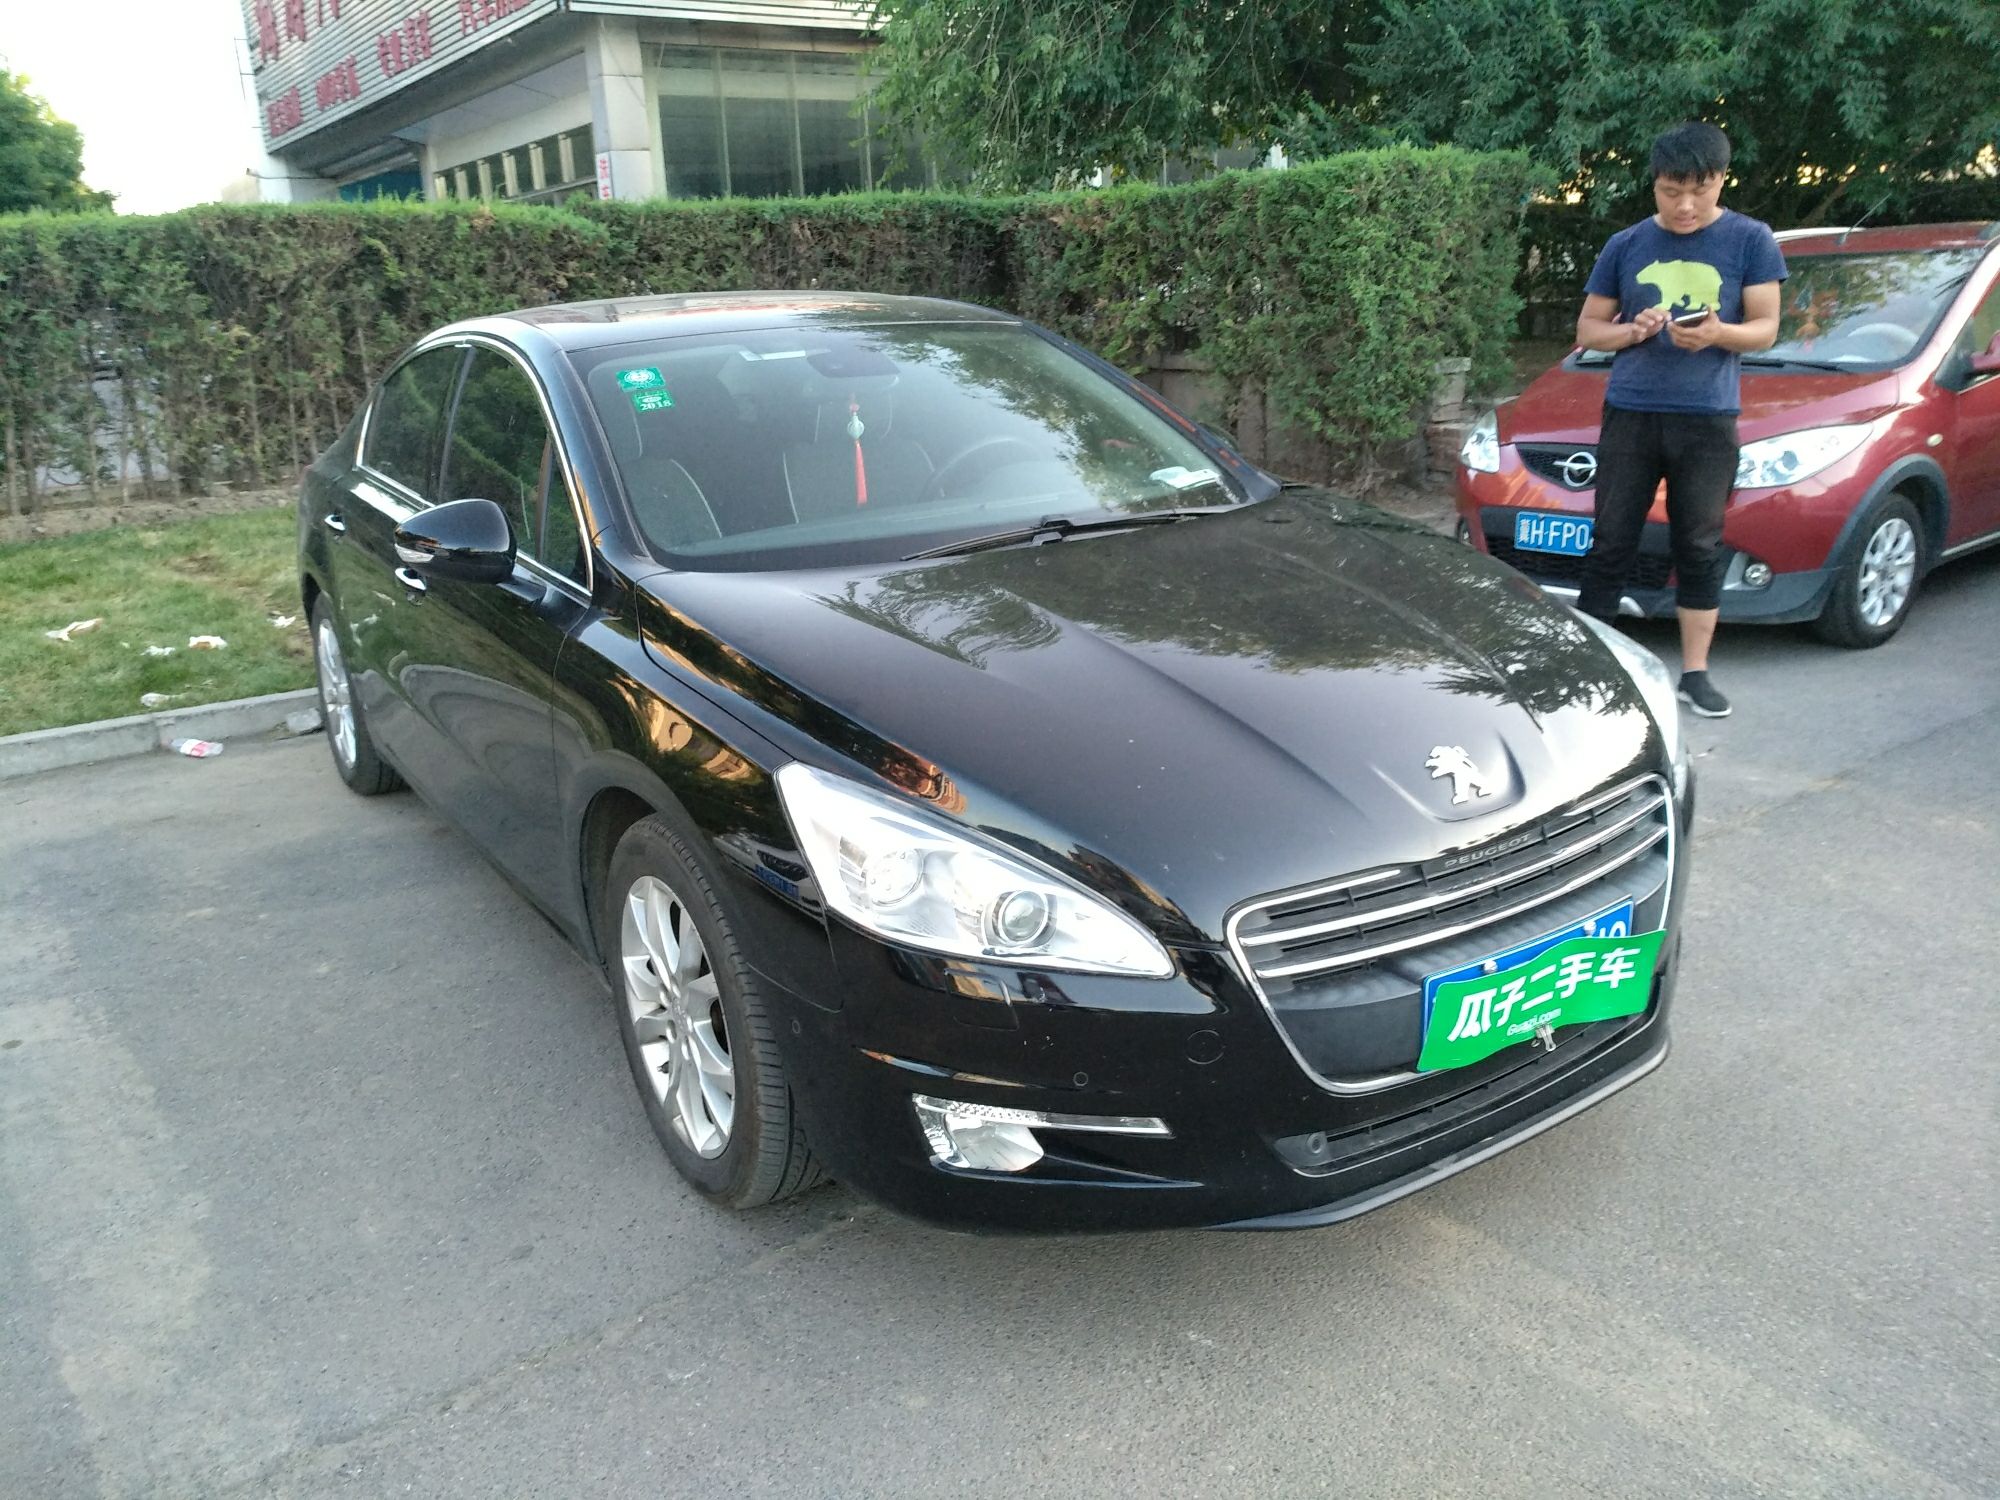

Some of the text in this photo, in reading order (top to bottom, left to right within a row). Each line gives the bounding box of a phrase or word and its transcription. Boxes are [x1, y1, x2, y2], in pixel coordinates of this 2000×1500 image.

[640, 400, 672, 411] 2018
[1444, 833, 1531, 868] PEUGEOT
[1447, 947, 1641, 1042] 瓜子二手车
